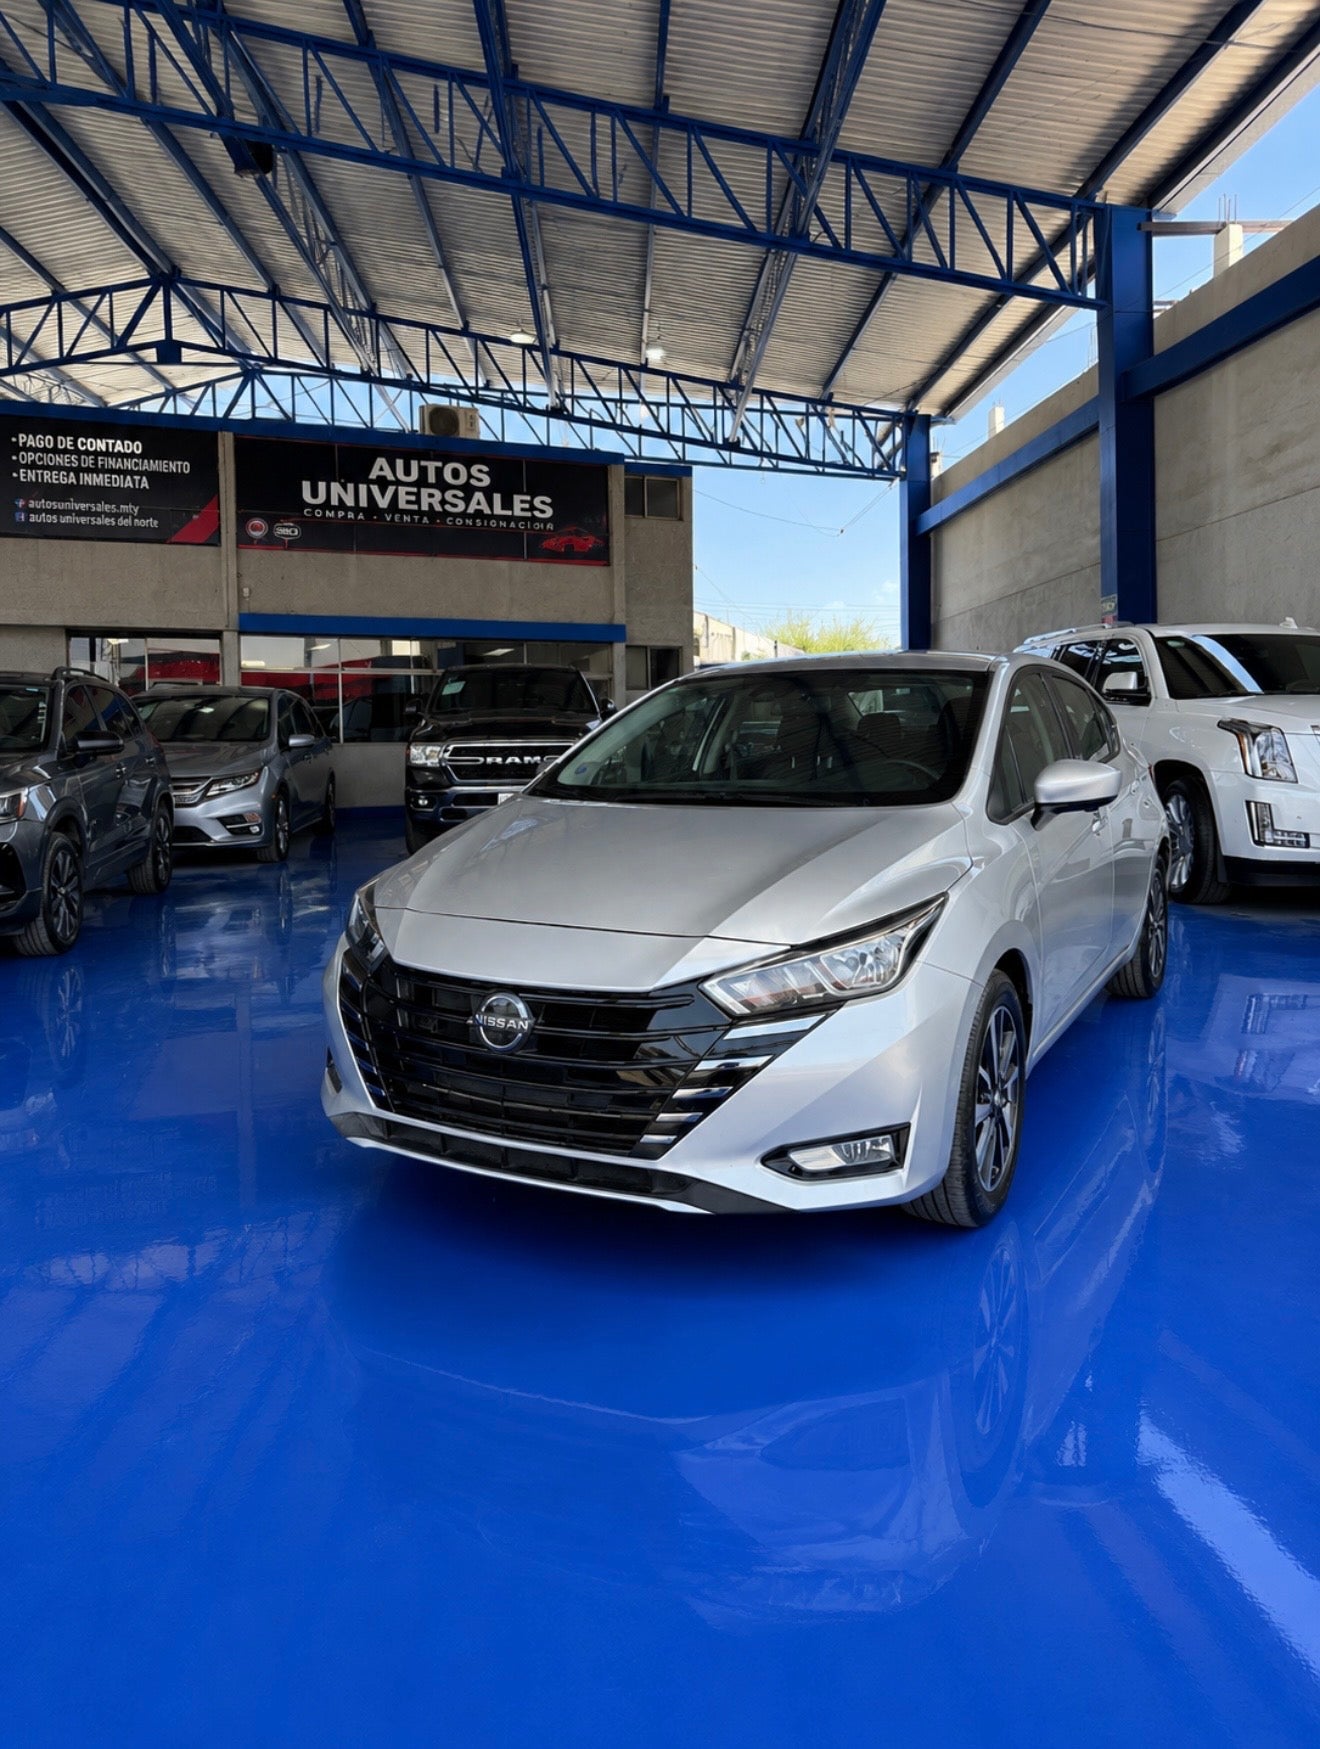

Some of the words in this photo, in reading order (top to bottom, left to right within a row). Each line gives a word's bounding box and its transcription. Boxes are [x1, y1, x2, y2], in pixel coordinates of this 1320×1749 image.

[18, 433, 54, 449] PAGO
[57, 436, 74, 450] DE
[77, 437, 142, 454] CONTADO
[19, 452, 78, 468] OPCIONES
[80, 455, 96, 468] DE
[98, 456, 191, 474] FINANCIAMIENTO
[368, 456, 490, 488] AUTOS
[19, 469, 77, 485] ENTREGA
[79, 473, 150, 490] INMEDIATA
[28, 498, 140, 516] autosuniversales.mty
[301, 480, 554, 519] UNIVERSALES
[29, 512, 58, 523] autos
[59, 512, 116, 527] universales
[117, 514, 132, 527] del
[134, 518, 159, 528] norte
[303, 507, 365, 521] COMPRA
[384, 513, 430, 525] VENTA
[486, 756, 541, 764] RAM
[475, 1014, 529, 1030] NISSAN
